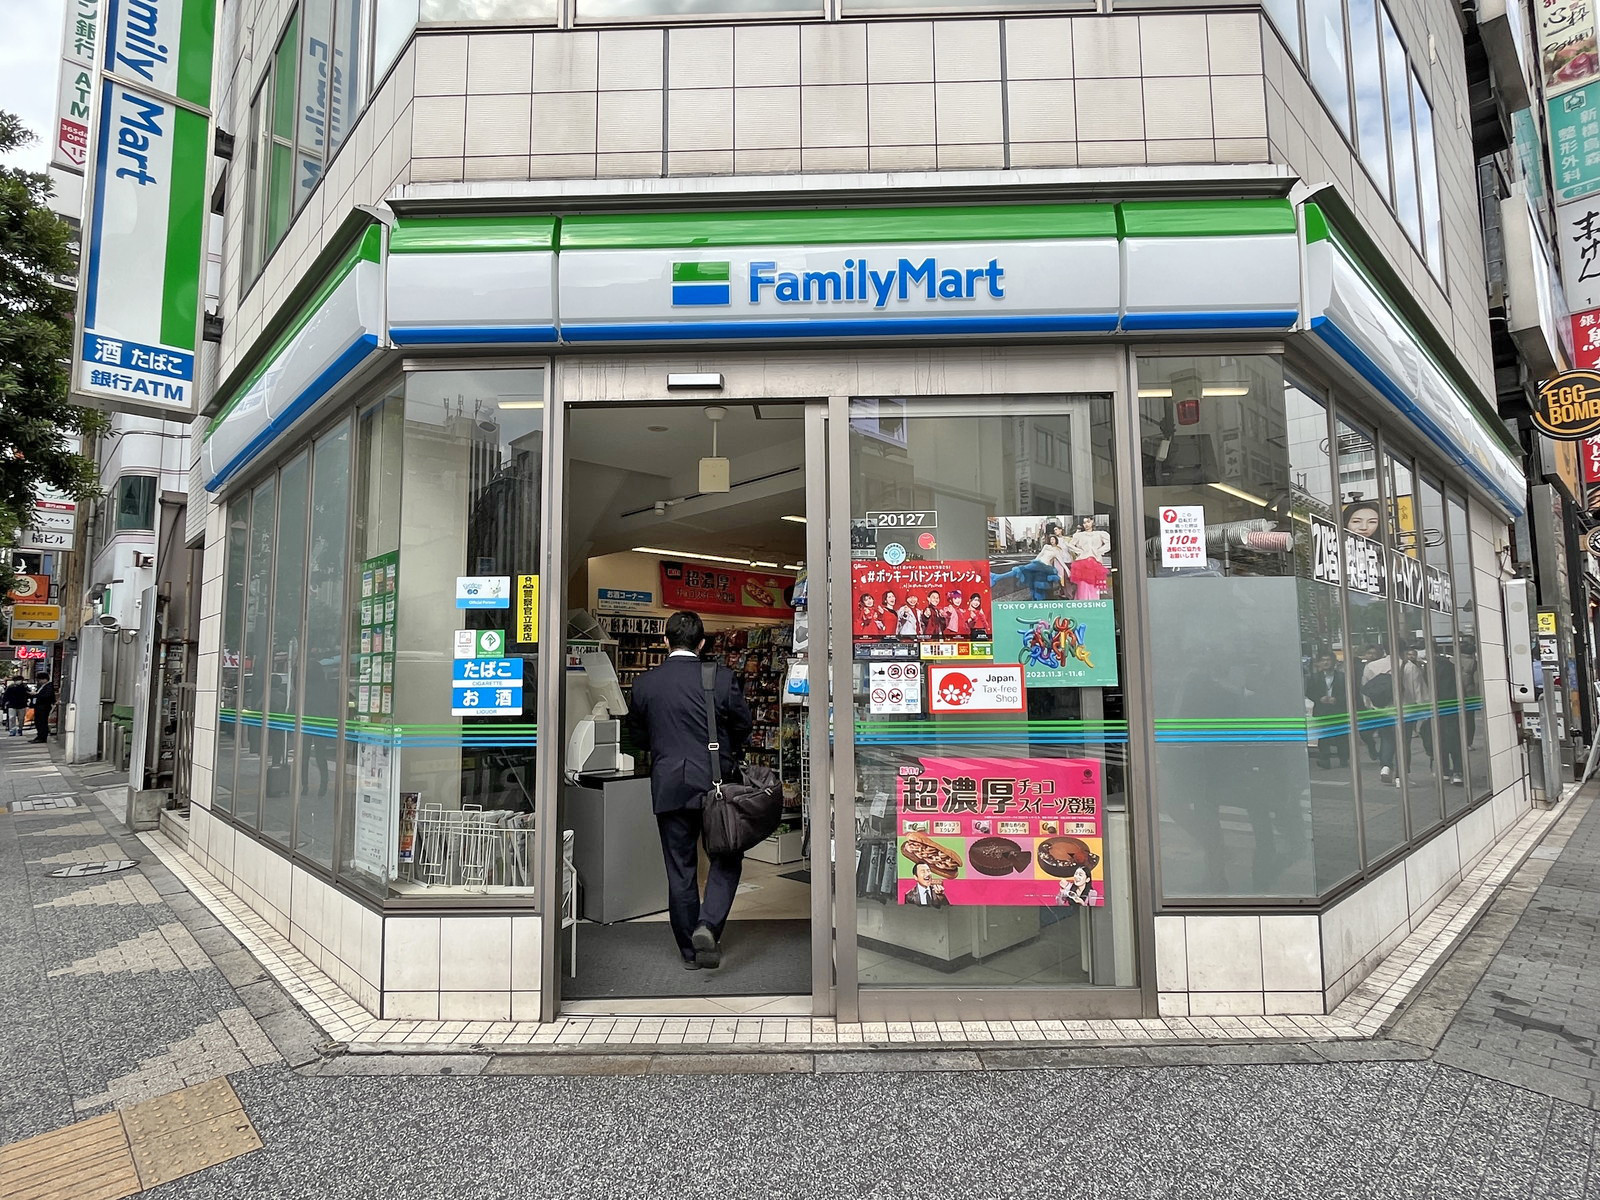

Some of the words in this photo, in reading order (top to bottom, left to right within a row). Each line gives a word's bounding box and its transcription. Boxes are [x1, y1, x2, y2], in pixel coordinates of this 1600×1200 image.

[117, 0, 168, 82] mily
[115, 92, 165, 187] Mart
[1558, 125, 1581, 184] 整形外科
[748, 257, 1005, 308] FamilyMart
[94, 338, 123, 365] 酒
[130, 348, 183, 375] たばこ
[90, 369, 184, 401] 銀行ATM
[1546, 384, 1586, 408] EGG
[1549, 398, 1600, 426] BOMB
[878, 513, 926, 526] 20127
[1169, 535, 1198, 545] 110番
[464, 661, 512, 678] たばこ
[986, 674, 1017, 683] Japan.
[982, 684, 1018, 693] Tax-free
[995, 694, 1018, 704] Shop
[902, 775, 1016, 814] 超濃厚
[1017, 779, 1055, 795] チョコ
[1018, 797, 1095, 815] スイーツ登場
